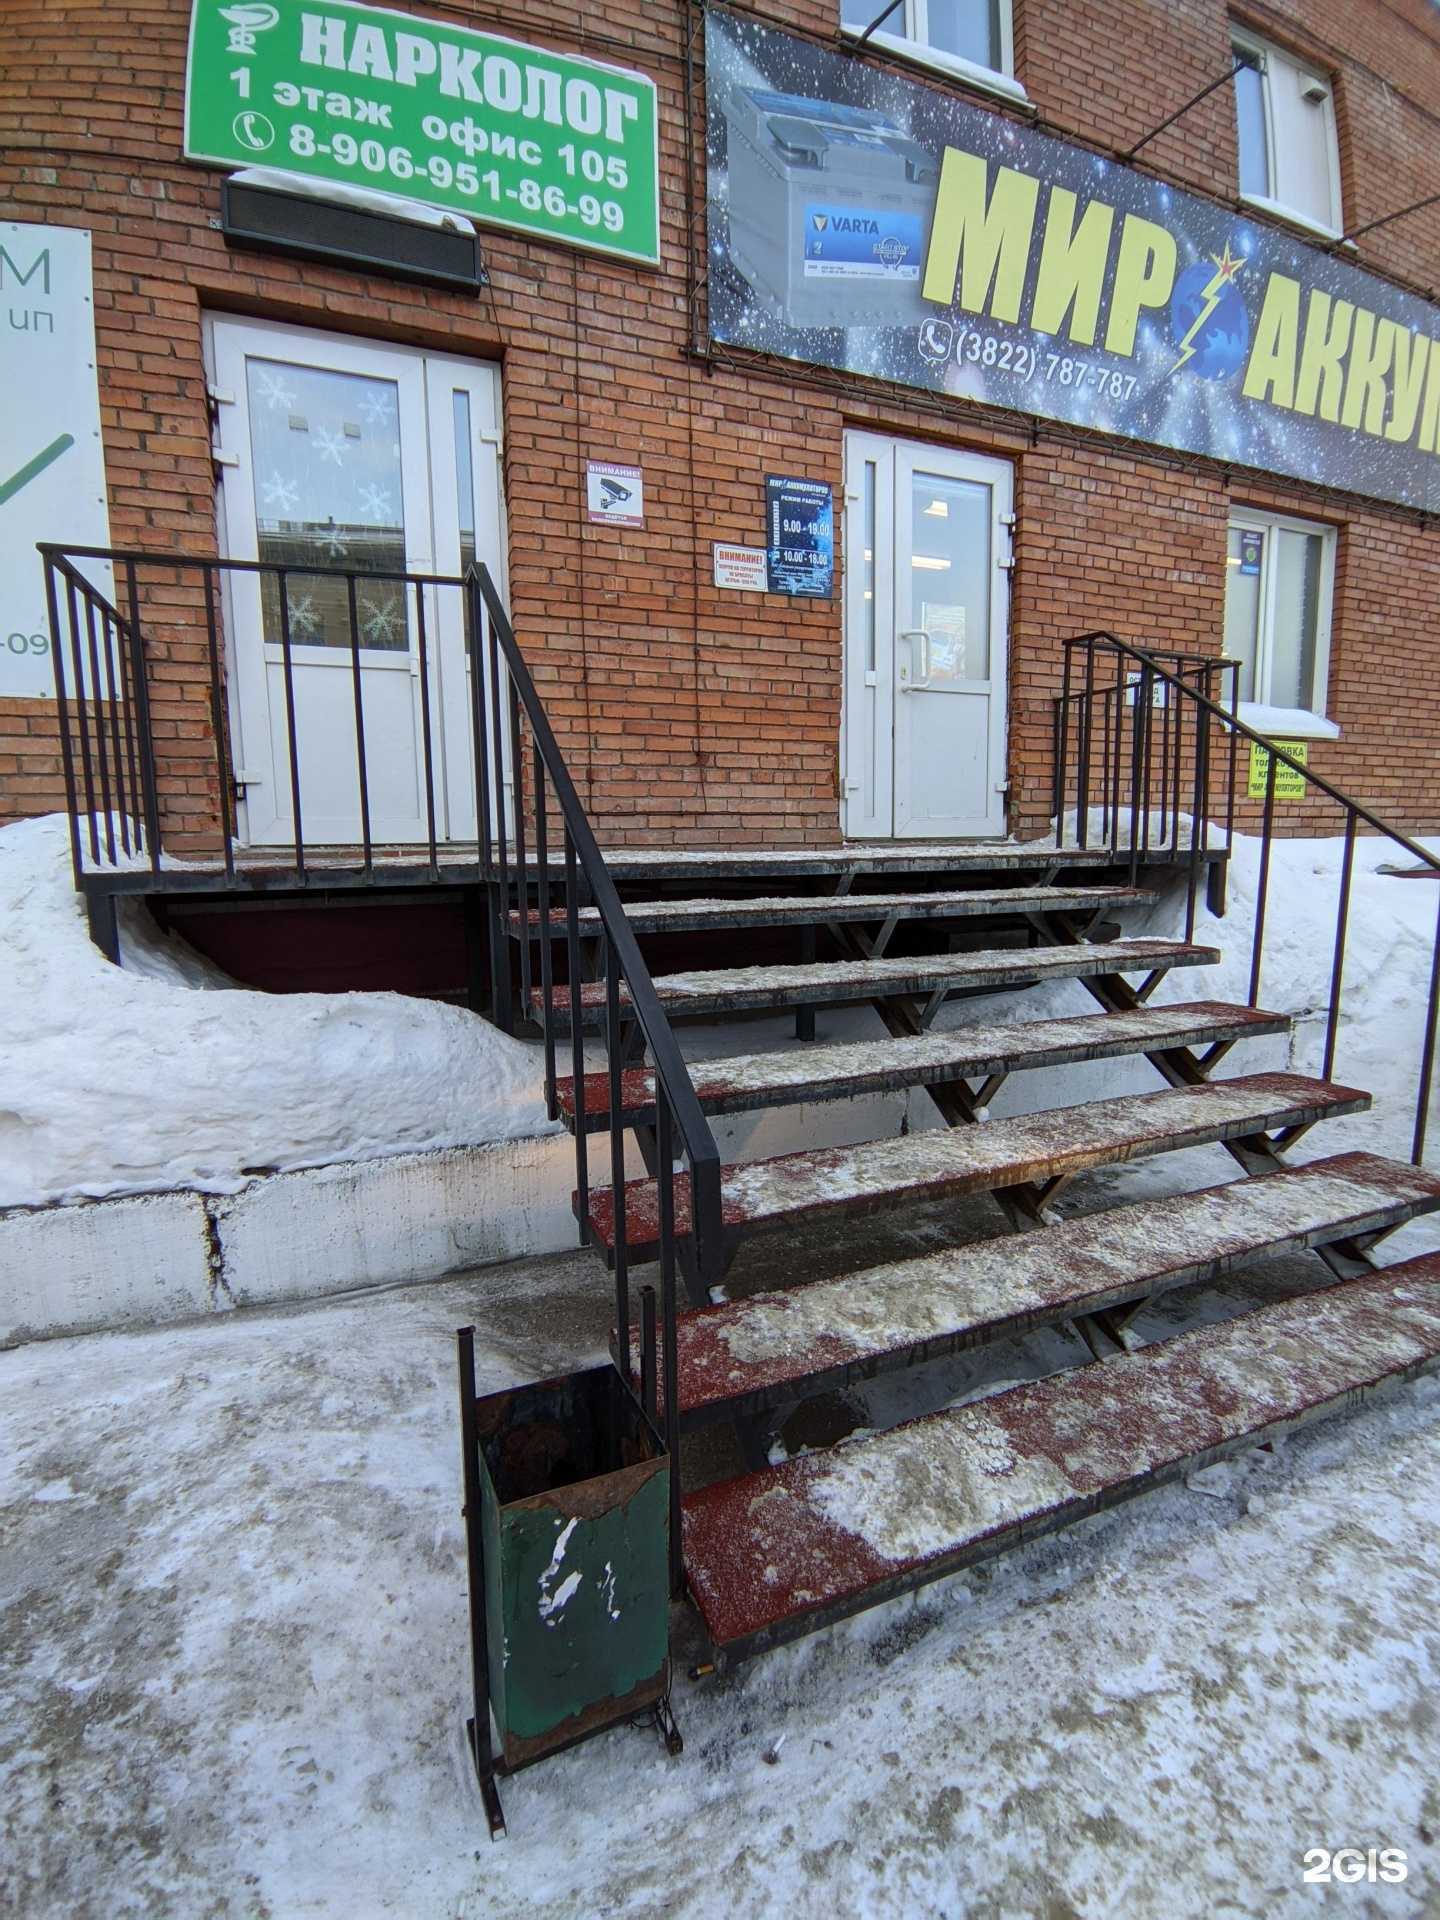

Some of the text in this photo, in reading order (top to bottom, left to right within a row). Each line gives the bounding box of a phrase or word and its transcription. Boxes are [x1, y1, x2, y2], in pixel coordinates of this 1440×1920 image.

[299, 12, 639, 144] НАРКОЛОГ
[230, 66, 629, 189] 1 этаж офис 105
[289, 123, 625, 233] 8-906-951-86-99
[831, 215, 880, 235] VARTA
[921, 144, 1178, 358] МИР
[956, 330, 1137, 400] (3822) 787-787
[589, 464, 641, 478] ВНИМАНИЕ!
[783, 519, 801, 533] 9.00
[719, 550, 763, 565] ВНИМАНИЕ!
[784, 550, 803, 563] 10.00
[1255, 744, 1304, 757] ПАОВКА
